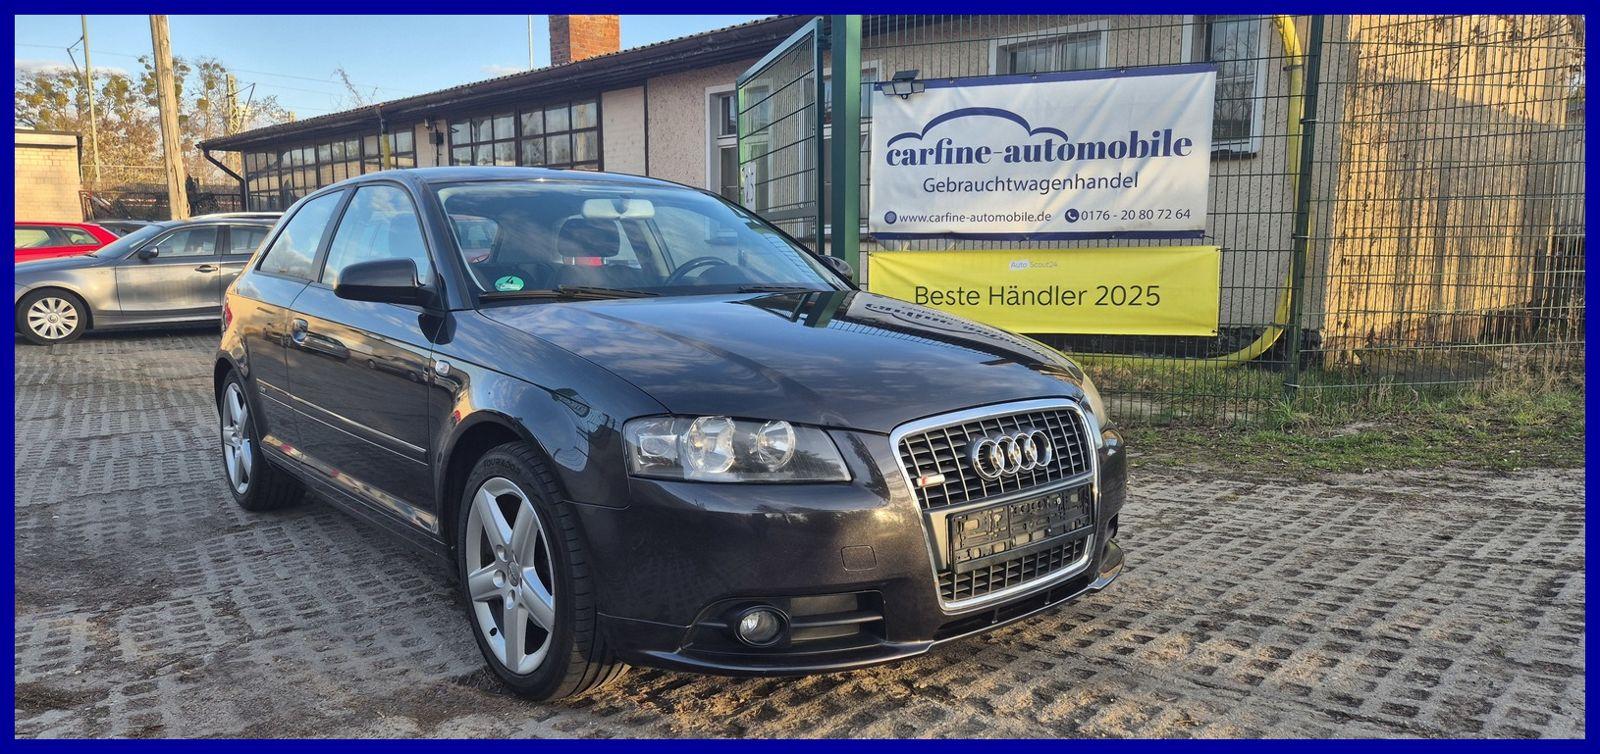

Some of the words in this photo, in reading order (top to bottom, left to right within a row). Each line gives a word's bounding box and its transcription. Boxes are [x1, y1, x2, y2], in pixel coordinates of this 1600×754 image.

[886, 128, 1193, 167] carfine-automobile
[922, 171, 1139, 196] Gebrauchtwagenhandel
[899, 210, 1052, 223] www.carfine-automobile.de
[1080, 210, 1111, 222] 0176
[1120, 209, 1136, 221] 20
[1138, 209, 1154, 221] 80
[1157, 208, 1172, 220] 72
[1175, 208, 1191, 220] 64
[914, 285, 981, 306] Beste
[988, 285, 1088, 306] Händler
[1095, 284, 1161, 306] 2025
